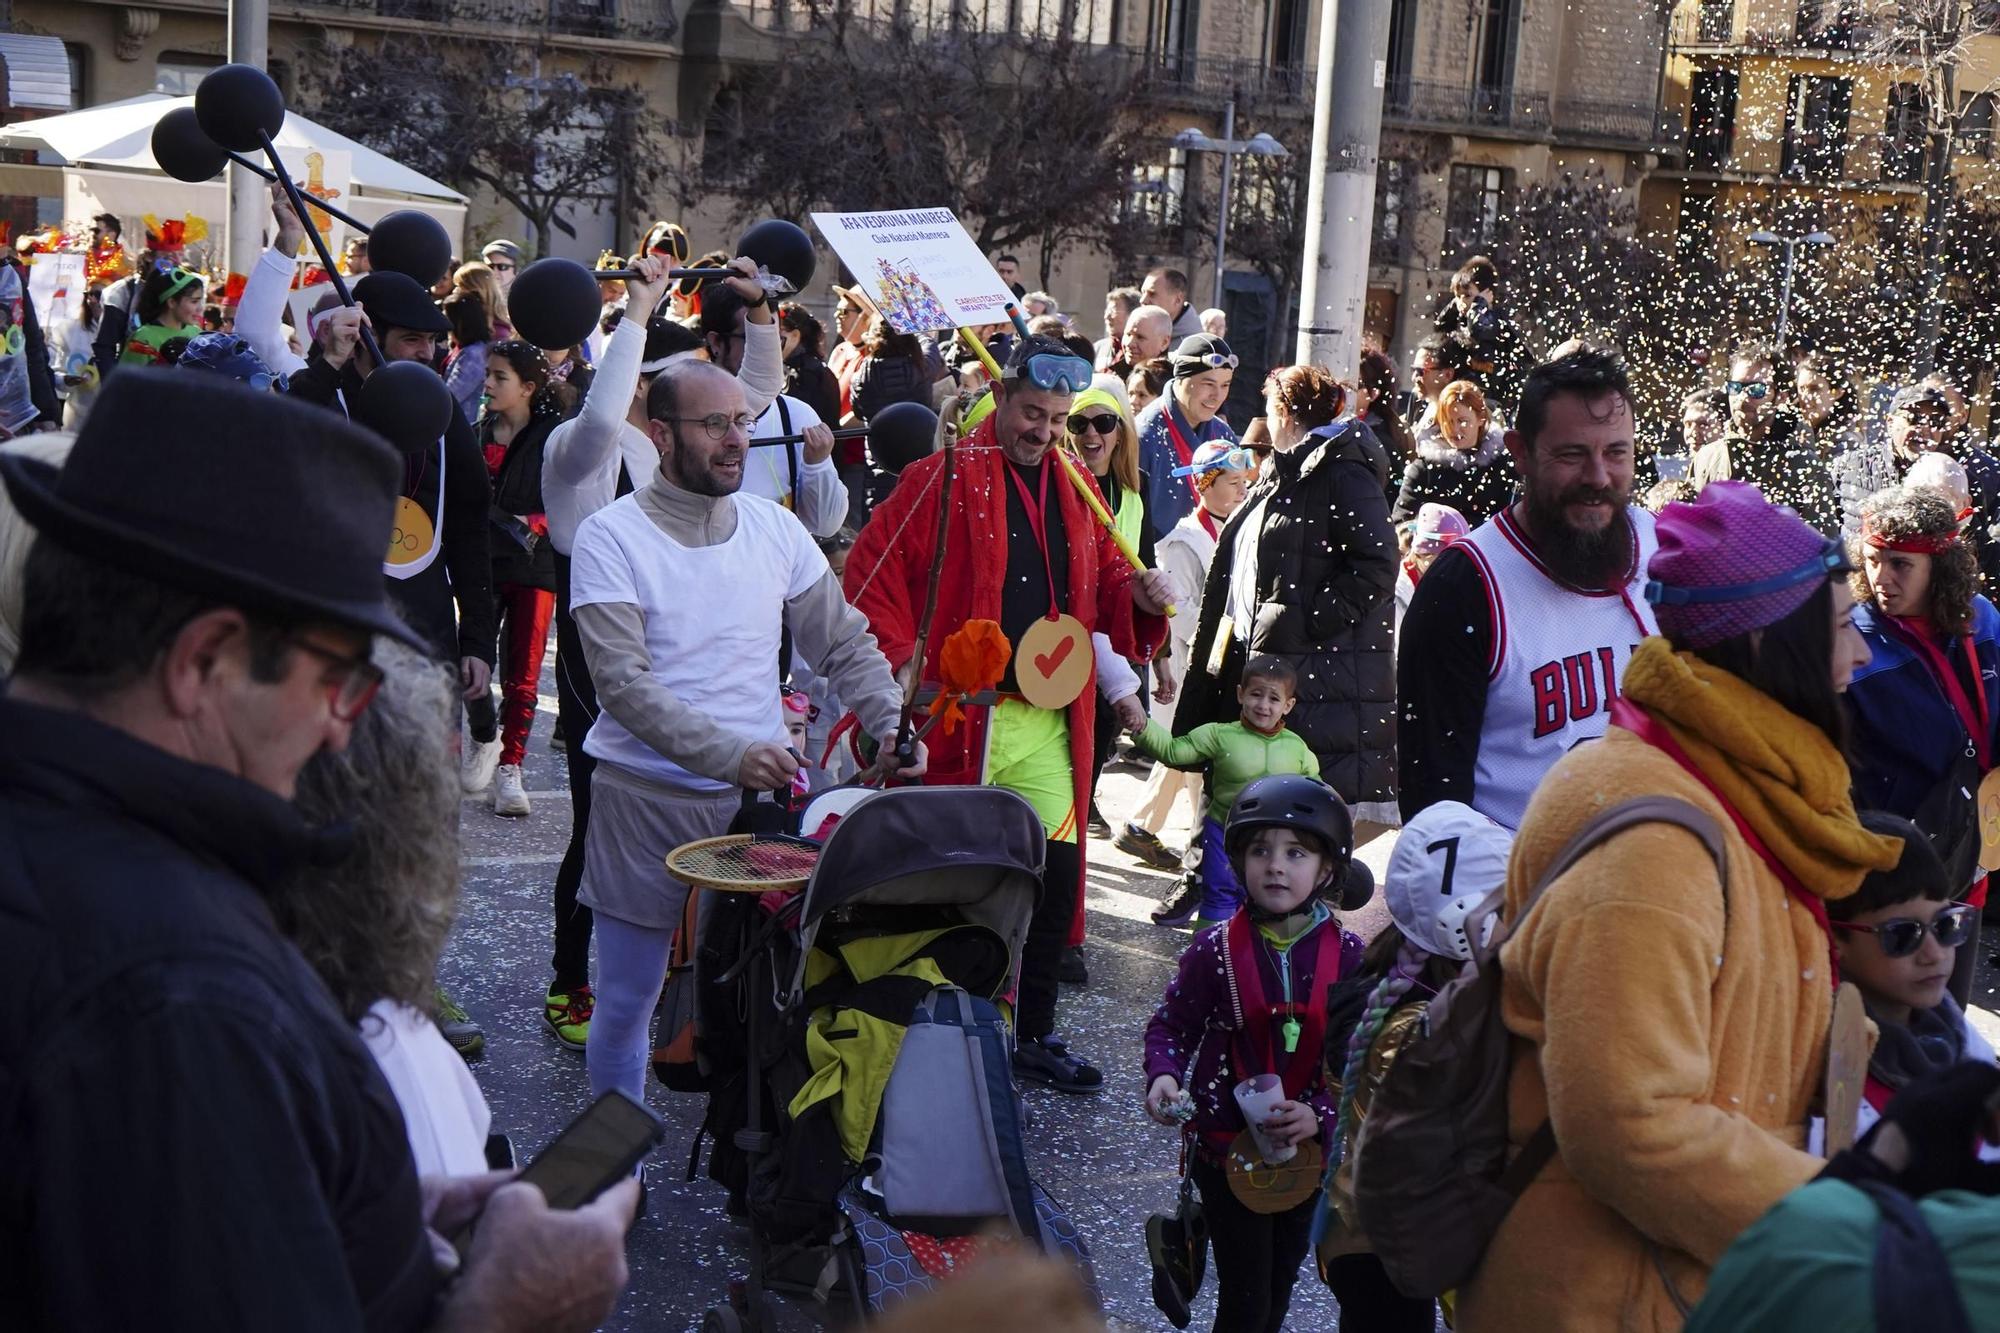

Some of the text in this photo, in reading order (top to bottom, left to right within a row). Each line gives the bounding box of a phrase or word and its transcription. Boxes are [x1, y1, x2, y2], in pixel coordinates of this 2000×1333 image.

[840, 210, 957, 230] AFA VEDRUNA MANRESA
[872, 230, 951, 244] Club Natació Manresa
[1530, 644, 1638, 739] BUL
[1426, 836, 1460, 896] 7
